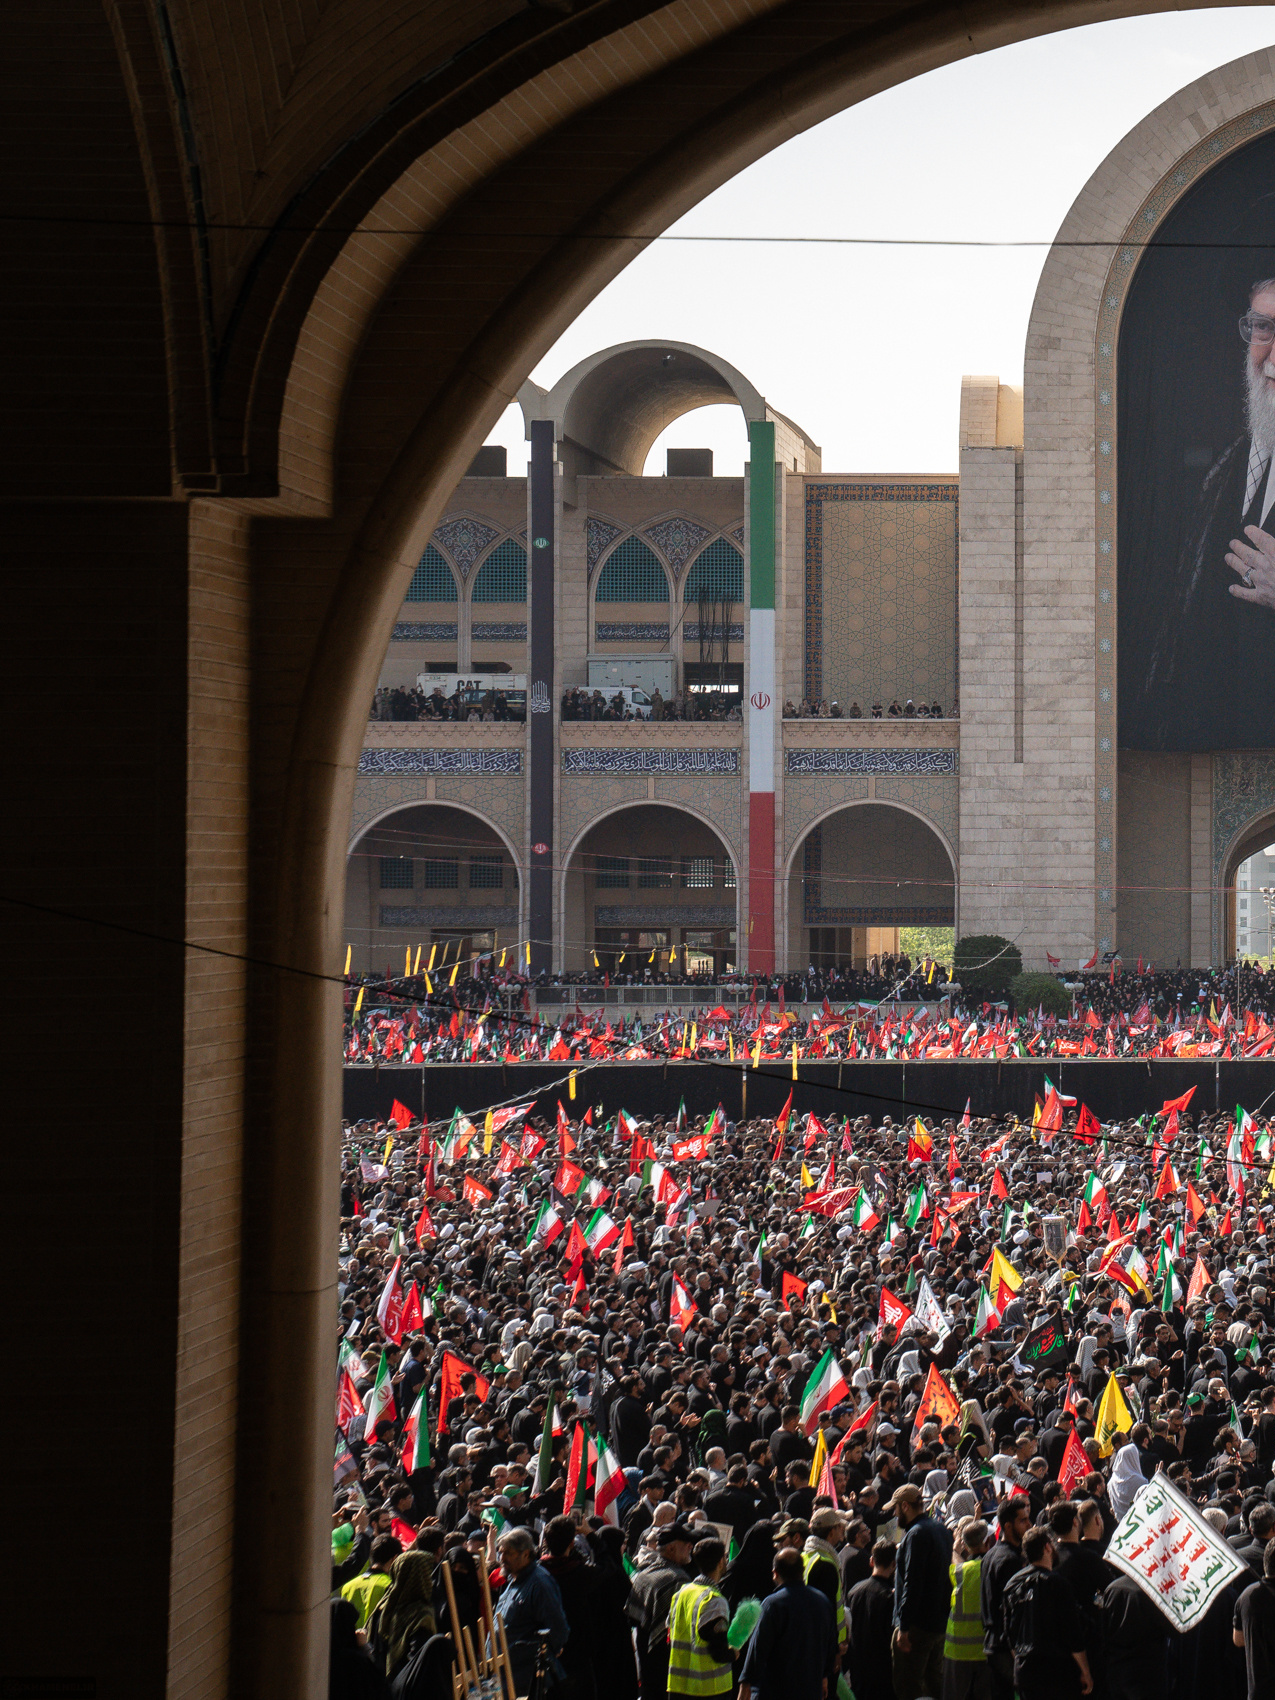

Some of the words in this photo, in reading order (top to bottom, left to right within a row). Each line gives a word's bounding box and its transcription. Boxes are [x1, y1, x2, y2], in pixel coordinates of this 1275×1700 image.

[457, 680, 483, 690] CAT
[1144, 1489, 1168, 1515] الله
[1158, 1508, 1183, 1534] الموت
[1171, 1523, 1196, 1554] الموت
[1186, 1538, 1211, 1563] اللعنة
[1200, 1552, 1227, 1588] النصر
[1157, 1572, 1179, 1595] اليهود
